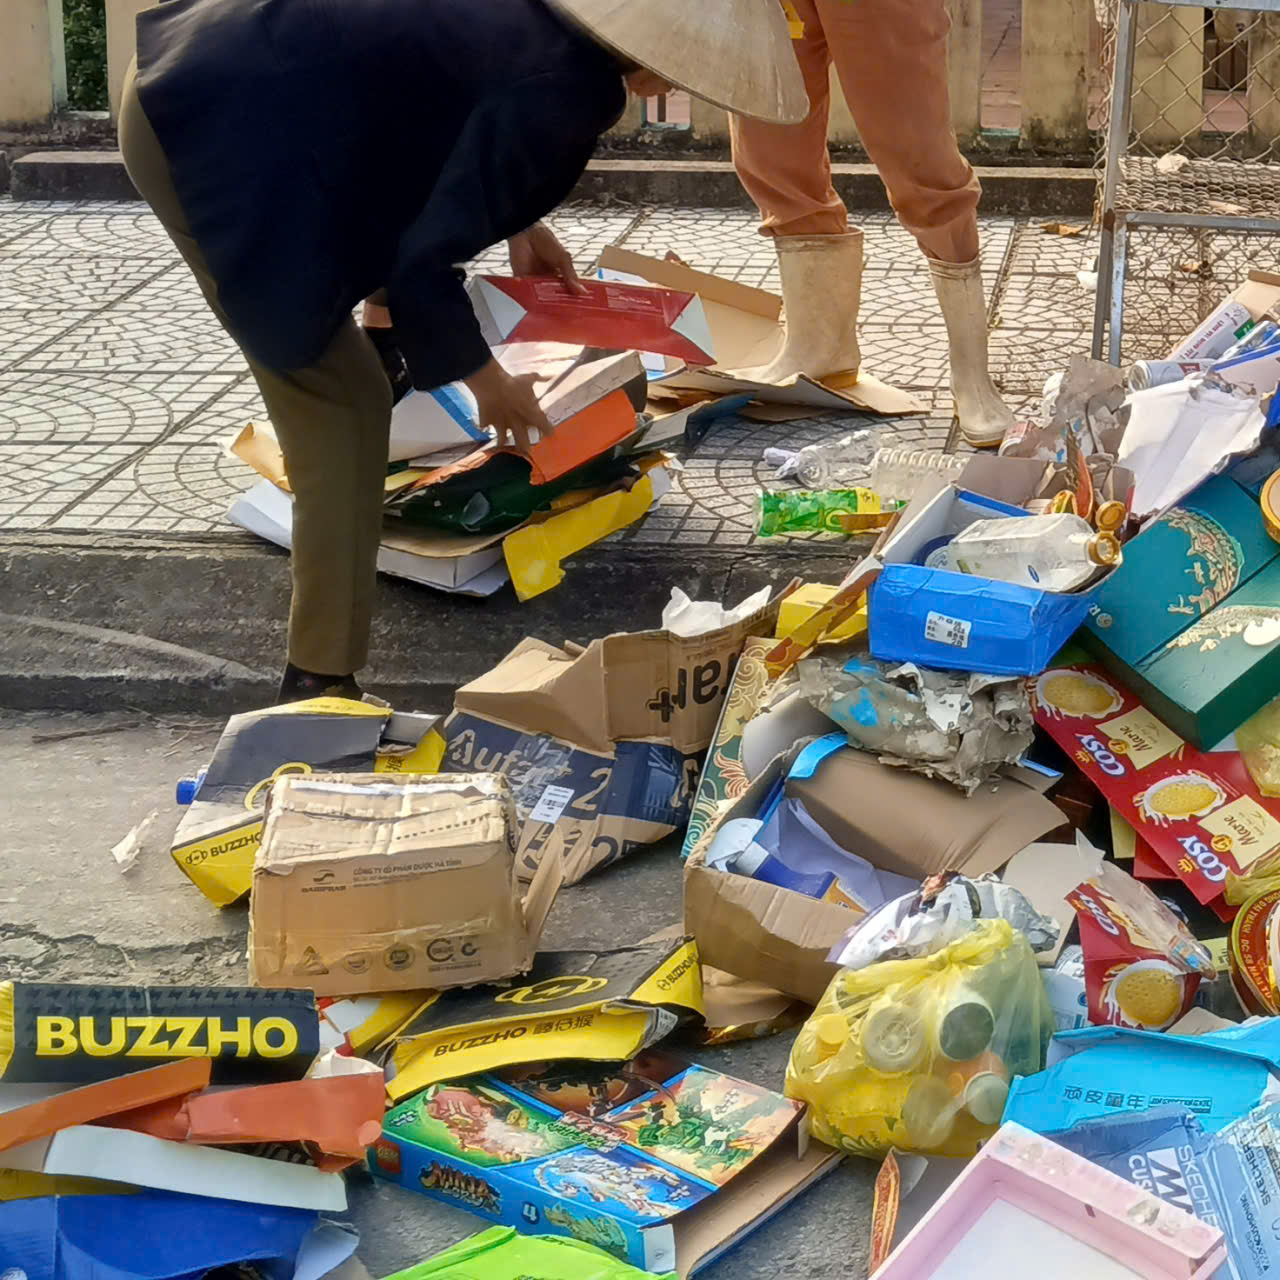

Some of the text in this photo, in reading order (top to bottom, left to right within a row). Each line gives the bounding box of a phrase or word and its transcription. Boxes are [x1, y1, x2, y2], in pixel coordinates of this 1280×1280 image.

[1075, 733, 1127, 777] COSY
[1224, 815, 1259, 846] Marie
[1177, 835, 1228, 883] COSY
[36, 1016, 298, 1058] BUZZHO
[434, 1026, 527, 1057] BUZZHO
[1178, 1144, 1218, 1228] SKECHE
[523, 1204, 538, 1221] 4
